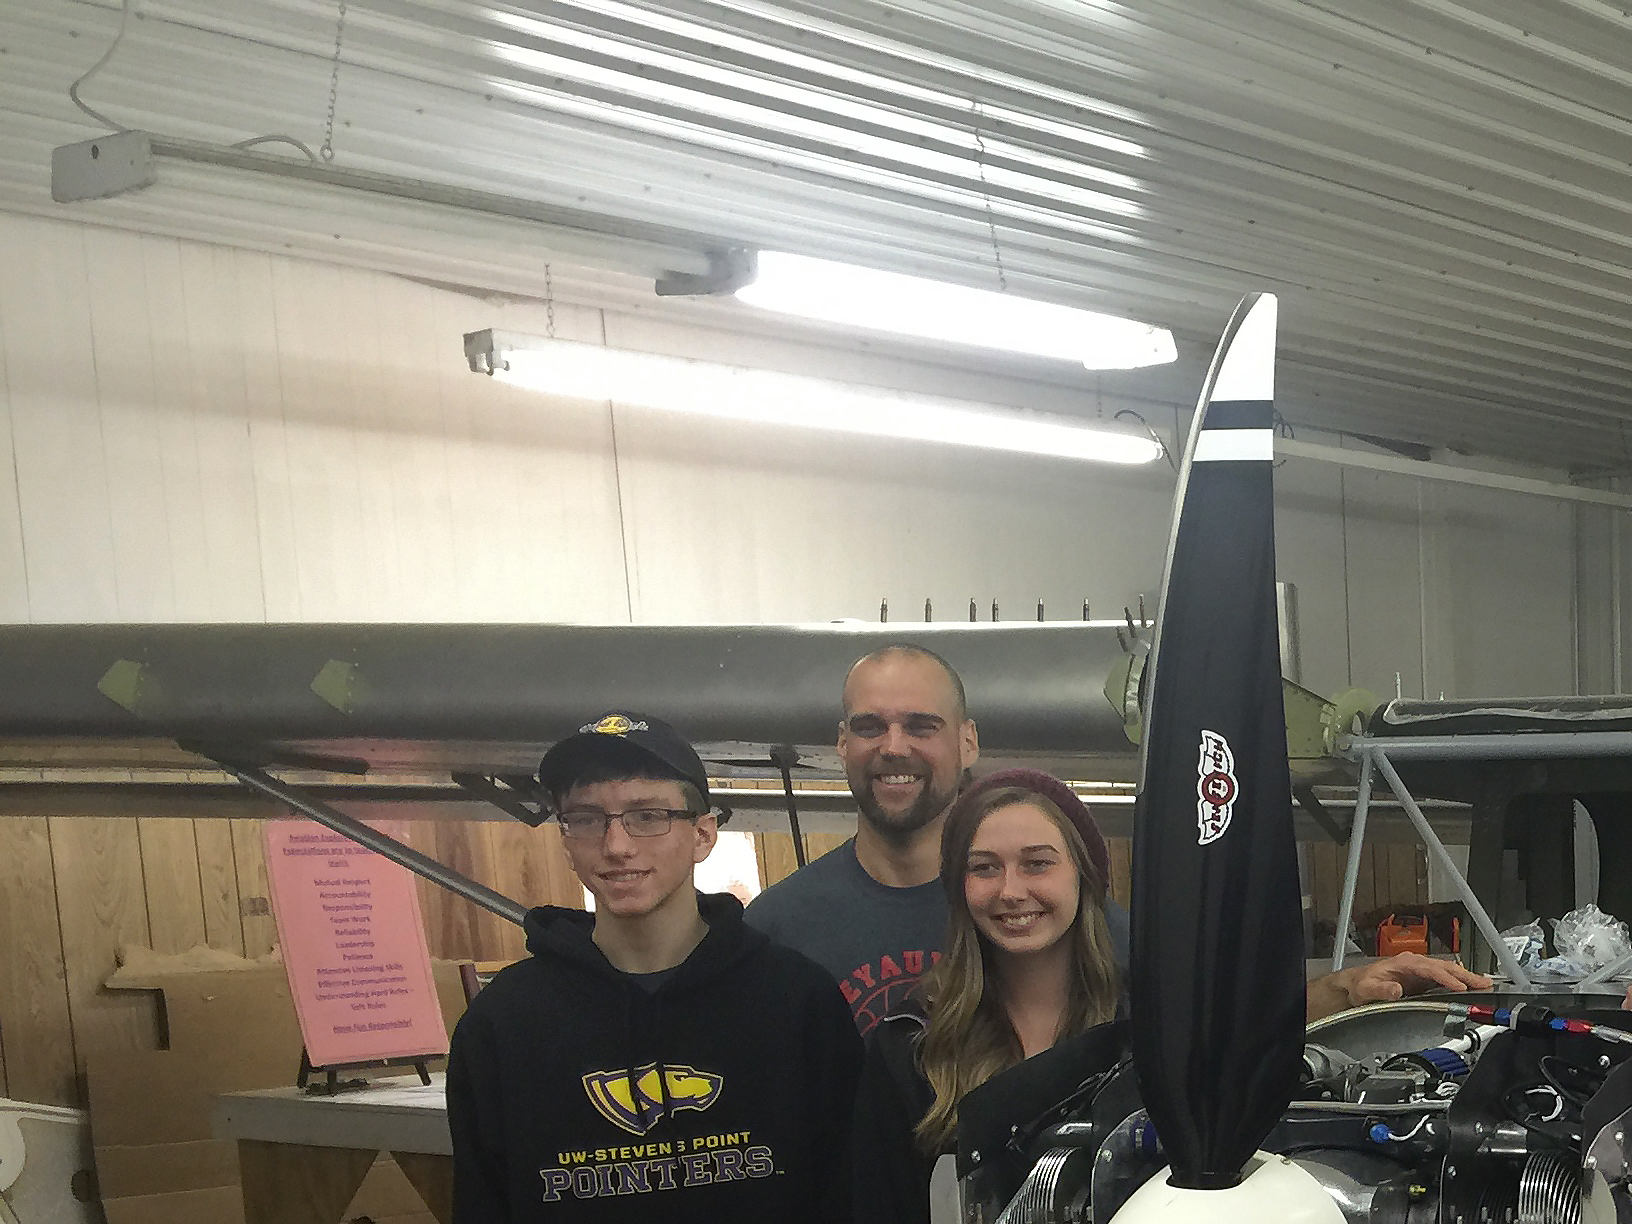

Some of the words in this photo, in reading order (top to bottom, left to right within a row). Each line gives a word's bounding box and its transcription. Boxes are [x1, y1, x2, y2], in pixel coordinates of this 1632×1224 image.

[839, 950, 942, 1004] EYAU
[692, 1131, 751, 1149] POINT
[539, 1145, 774, 1202] POINTERS
